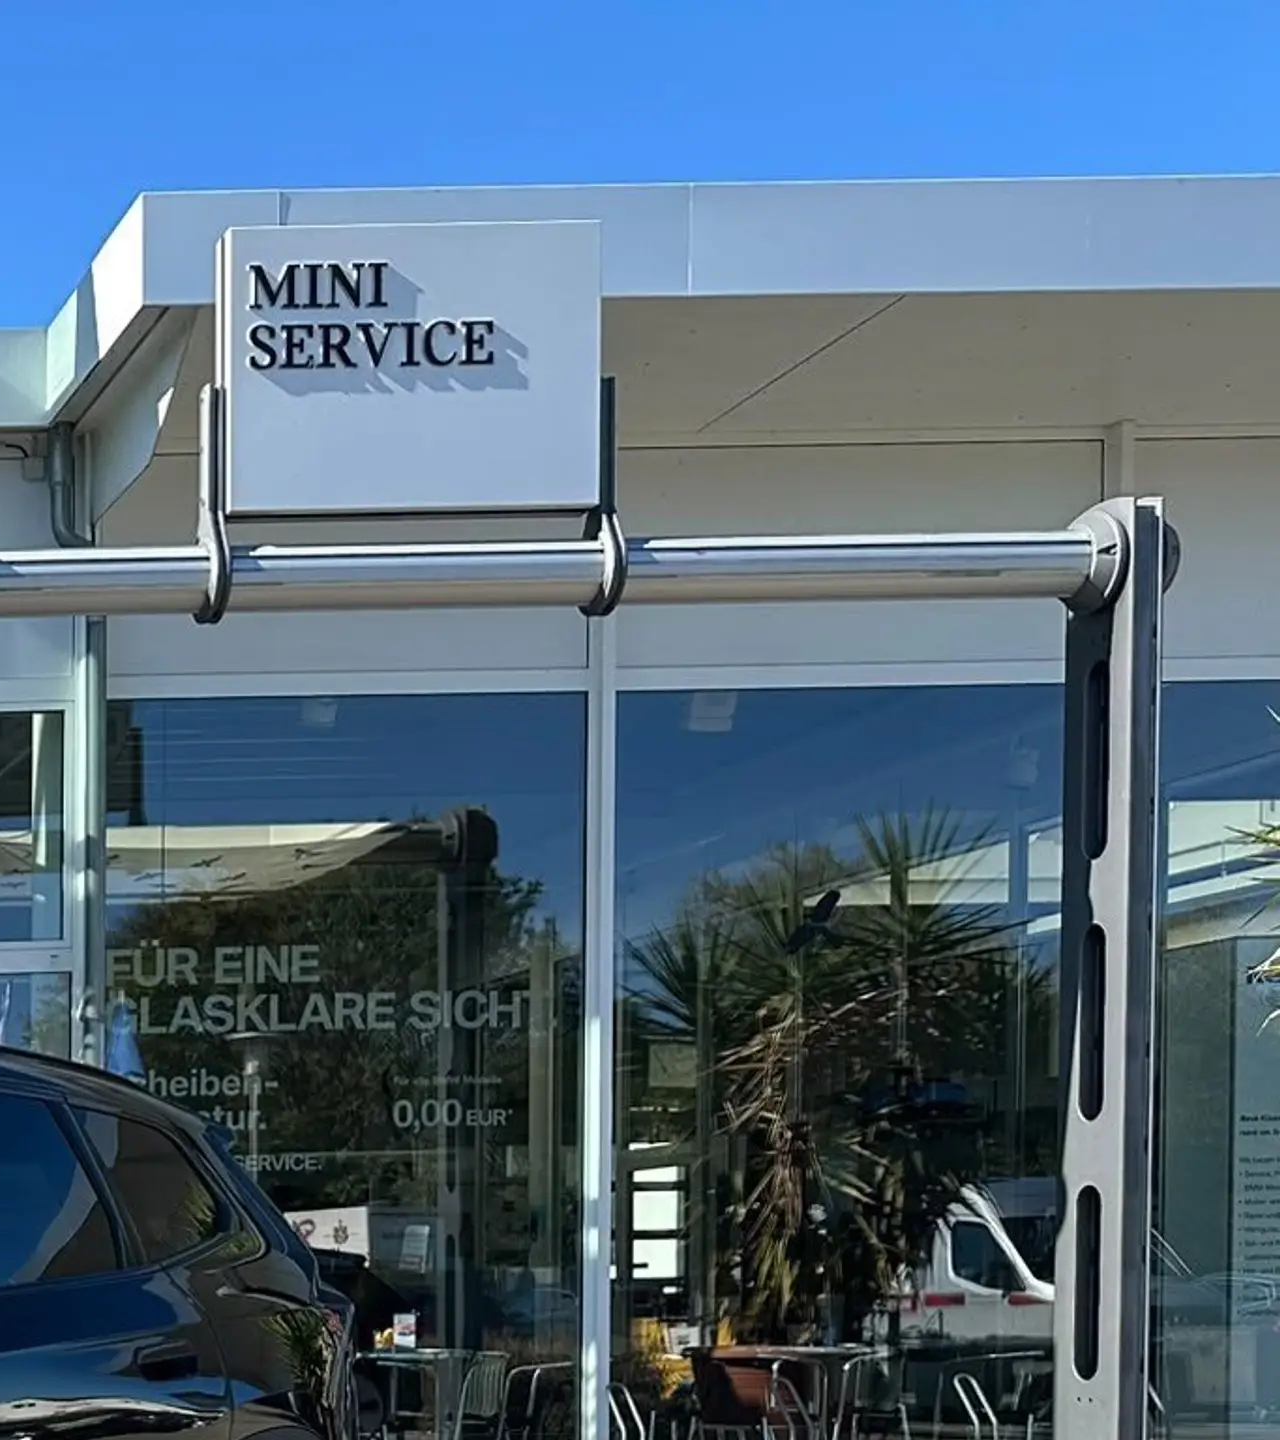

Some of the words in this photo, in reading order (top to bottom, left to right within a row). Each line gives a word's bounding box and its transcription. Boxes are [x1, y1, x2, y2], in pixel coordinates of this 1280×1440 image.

[249, 262, 389, 310] MINI
[249, 320, 494, 369] SERVICE
[106, 939, 199, 988] FÜR
[215, 945, 321, 984] EINE
[147, 1068, 279, 1097] heiben-
[393, 1099, 462, 1133] 0,00
